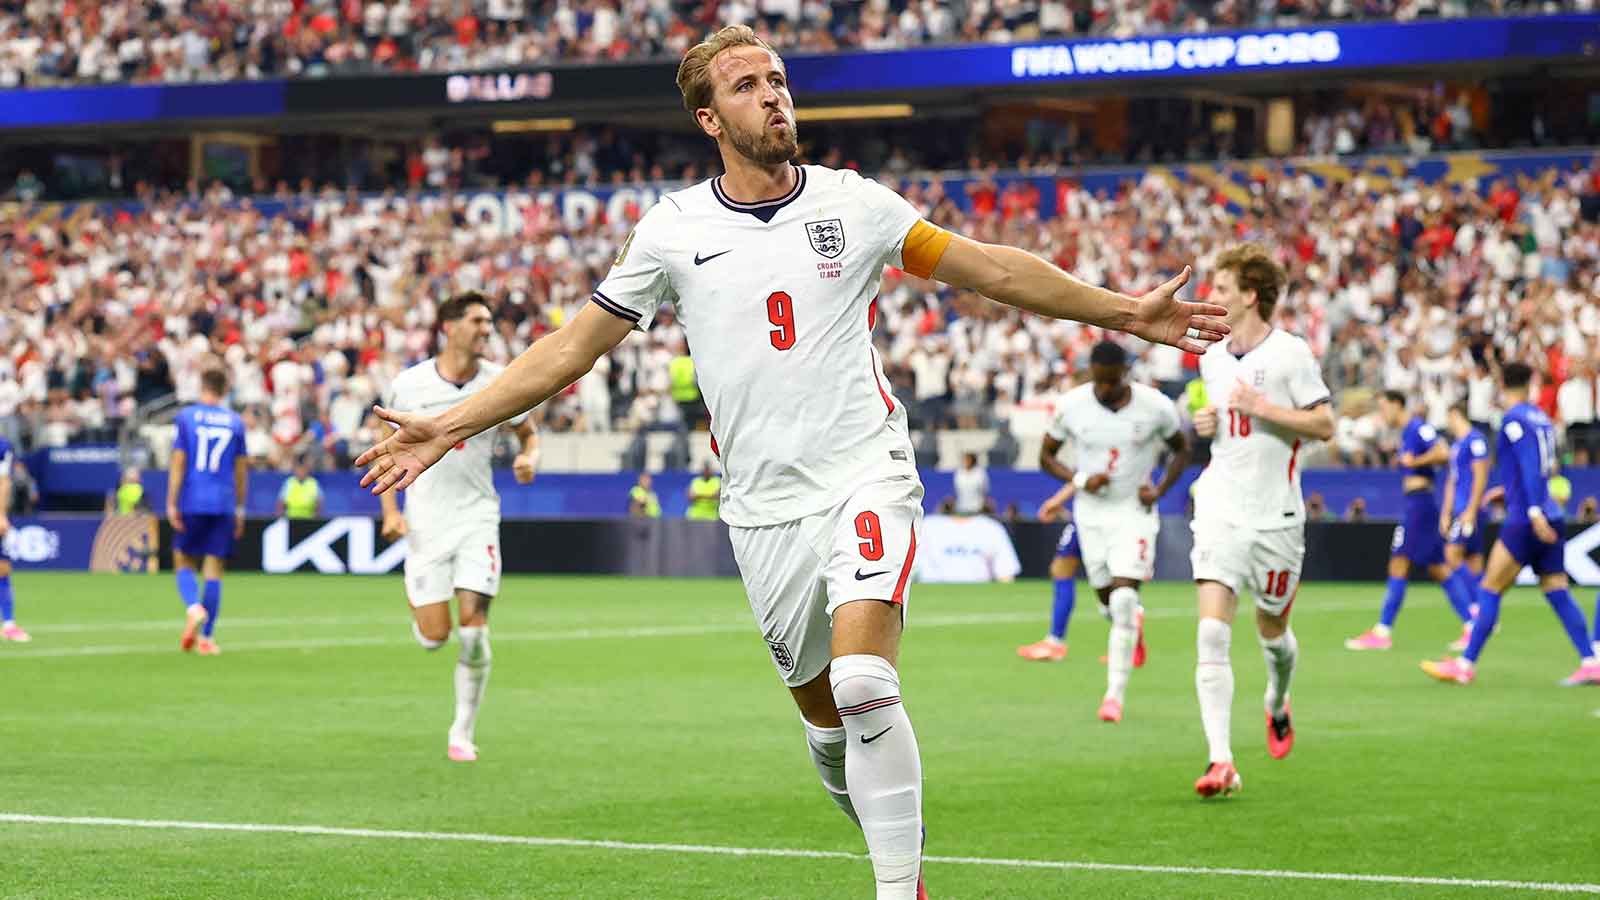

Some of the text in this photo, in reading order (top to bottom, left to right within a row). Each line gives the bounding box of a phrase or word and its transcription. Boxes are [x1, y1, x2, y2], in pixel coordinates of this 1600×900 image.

[1011, 30, 1340, 77] FIFA WORLD CUP 2026
[816, 262, 843, 270] CROATIA
[766, 290, 796, 351] 9
[1228, 407, 1251, 438] 18
[195, 425, 233, 473] 17
[854, 510, 885, 562] 9
[1265, 568, 1291, 598] 18
